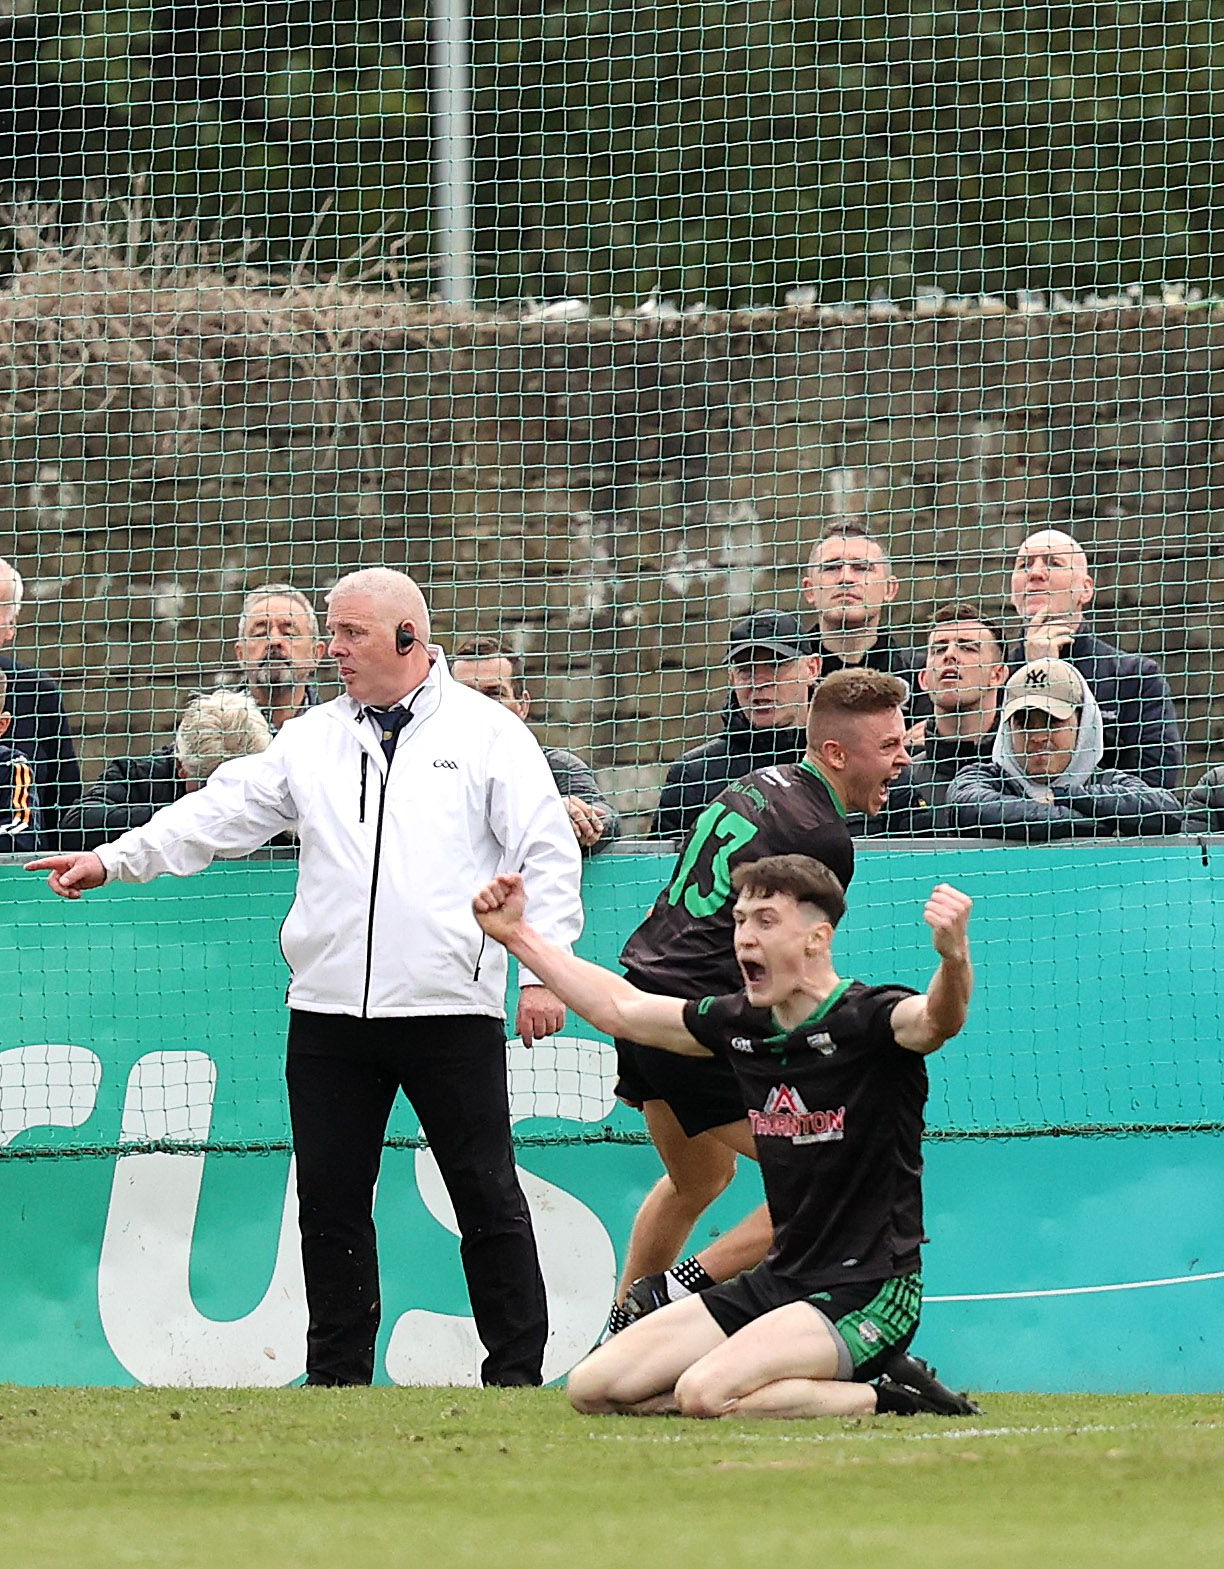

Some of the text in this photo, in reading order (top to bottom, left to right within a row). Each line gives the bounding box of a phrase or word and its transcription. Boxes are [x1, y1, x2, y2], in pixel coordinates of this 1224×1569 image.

[432, 758, 459, 770] GAA
[668, 801, 760, 919] 13
[747, 1105, 846, 1138] THORNTON
